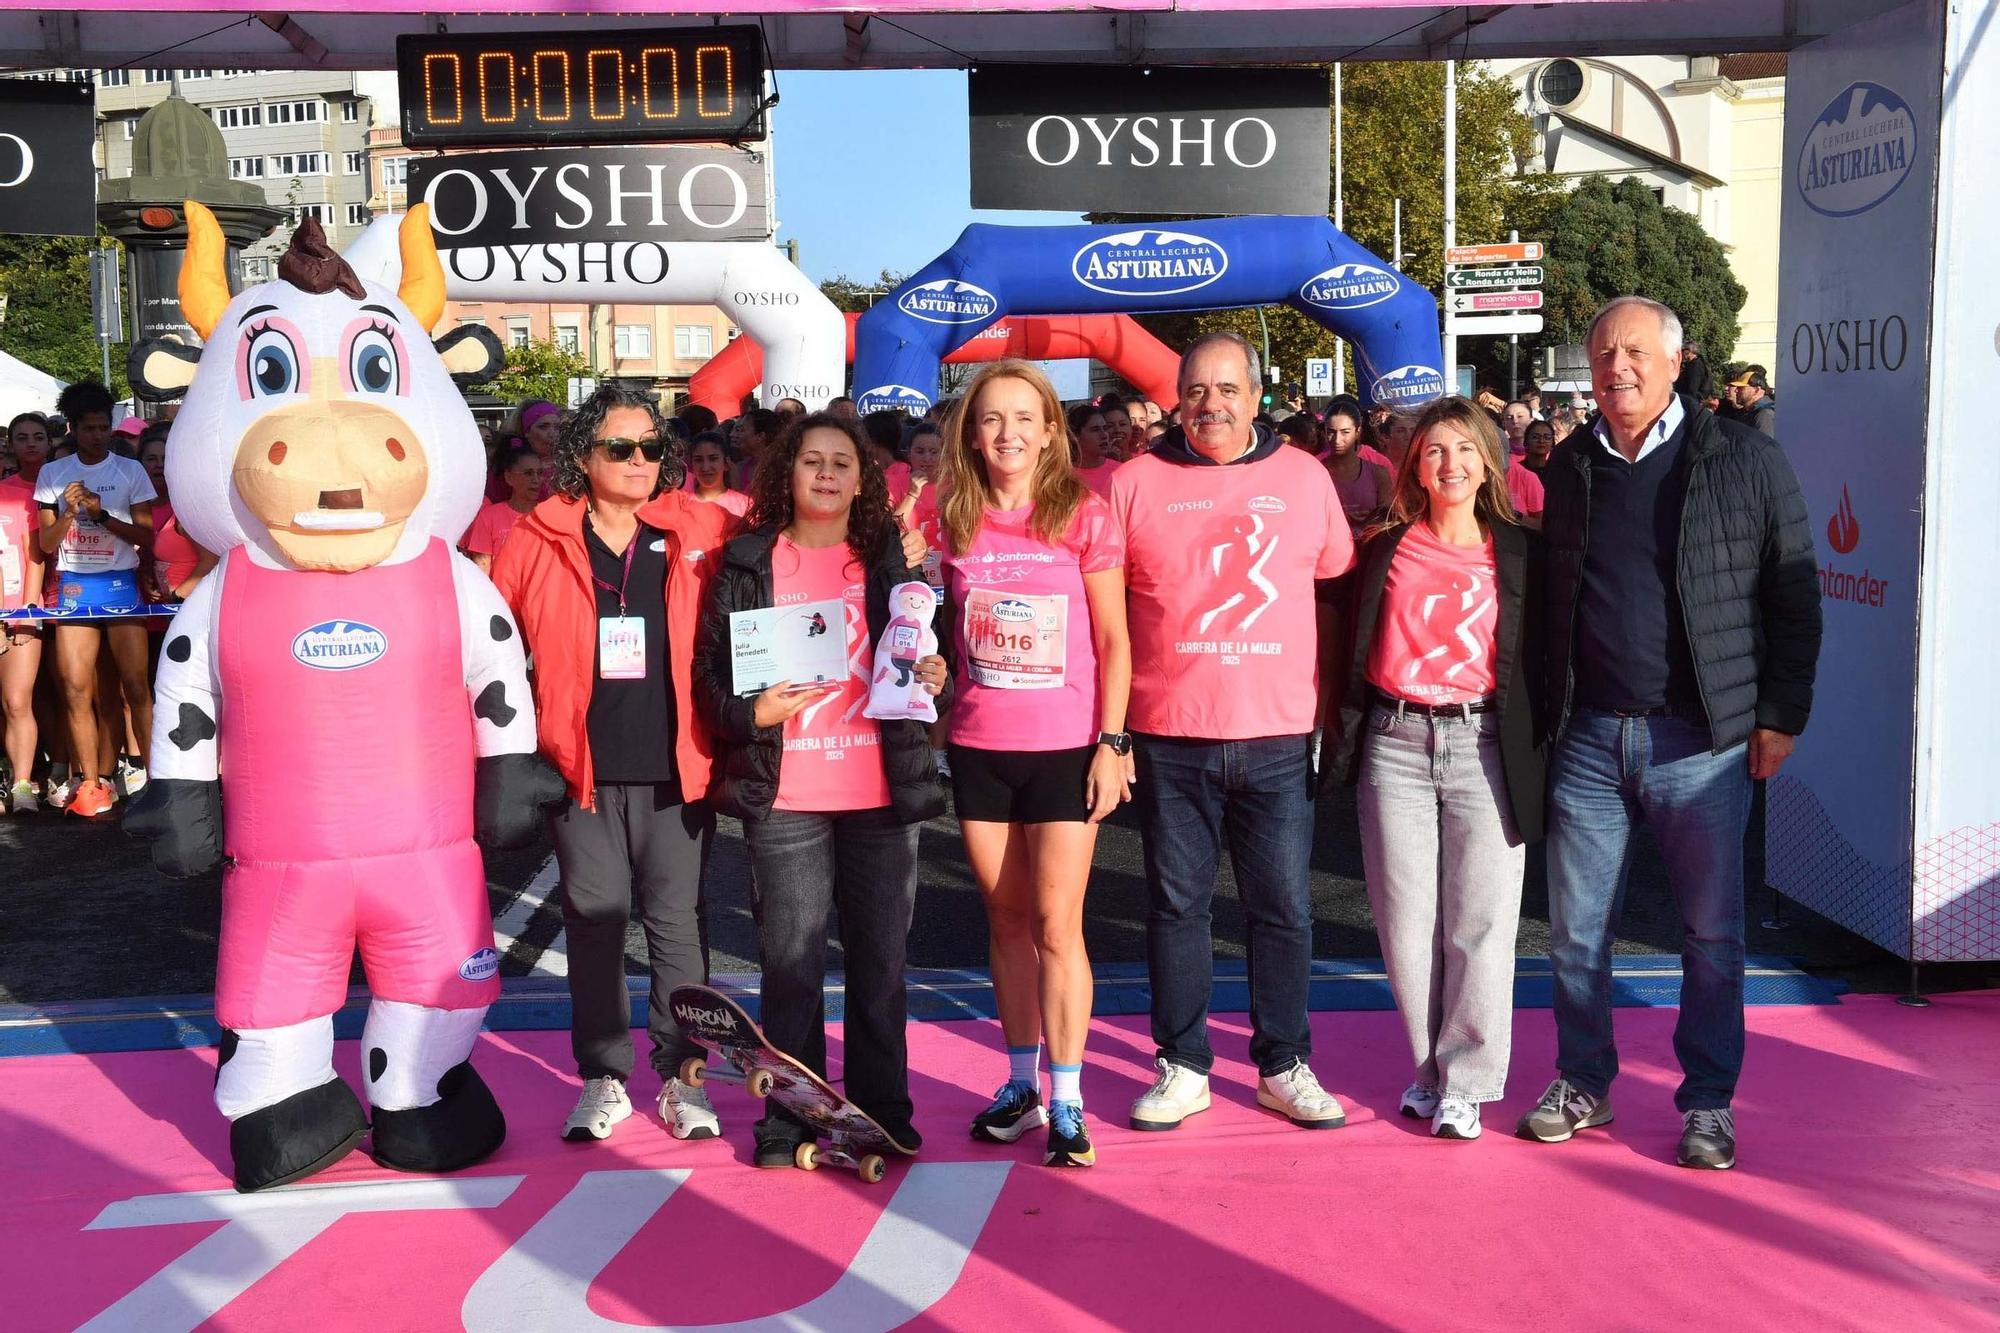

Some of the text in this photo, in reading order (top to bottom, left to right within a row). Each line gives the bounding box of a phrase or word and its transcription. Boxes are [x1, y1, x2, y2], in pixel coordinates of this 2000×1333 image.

[424, 46, 733, 124] 00:00:00
[1822, 118, 1905, 149] CENTRAL LECHERA
[1027, 115, 1277, 168] OYSHO
[1804, 136, 1907, 191] ASTURIANA
[424, 163, 748, 236] OYSHO
[1108, 247, 1211, 258] CENTRAL LECHERA
[449, 241, 670, 285] OYSHO
[1084, 252, 1217, 281] ASTURIANA
[1323, 275, 1389, 288] CENTRAL LECHERA
[1507, 277, 1538, 285] Outeiro
[734, 291, 799, 306] OYSHO
[922, 292, 953, 301] CENTRAL
[1310, 281, 1394, 301] ASTURIANA
[905, 294, 989, 315] ASTURIANA
[1792, 315, 1908, 375] OYSHO
[770, 383, 830, 398] OYSHO
[1378, 381, 1442, 400] ASTURIANA
[1167, 500, 1214, 513] OYSHO
[79, 535, 100, 544] 016
[996, 552, 1055, 563] Santander
[924, 569, 936, 578] 16
[1816, 562, 1889, 608] ntander
[774, 592, 809, 604] YSHO
[995, 606, 1033, 618] ASTURIANA
[299, 639, 380, 657] ASTURIANA
[735, 642, 750, 650] Julia
[994, 633, 1033, 651] 016
[1175, 641, 1283, 655] CARRERA DE LA MUJER
[735, 648, 769, 657] Benedetti
[1002, 655, 1022, 663] 2612
[1221, 655, 1241, 665] 2025
[783, 737, 821, 751] CARRERA
[823, 736, 837, 749] DE
[840, 735, 852, 747] LA
